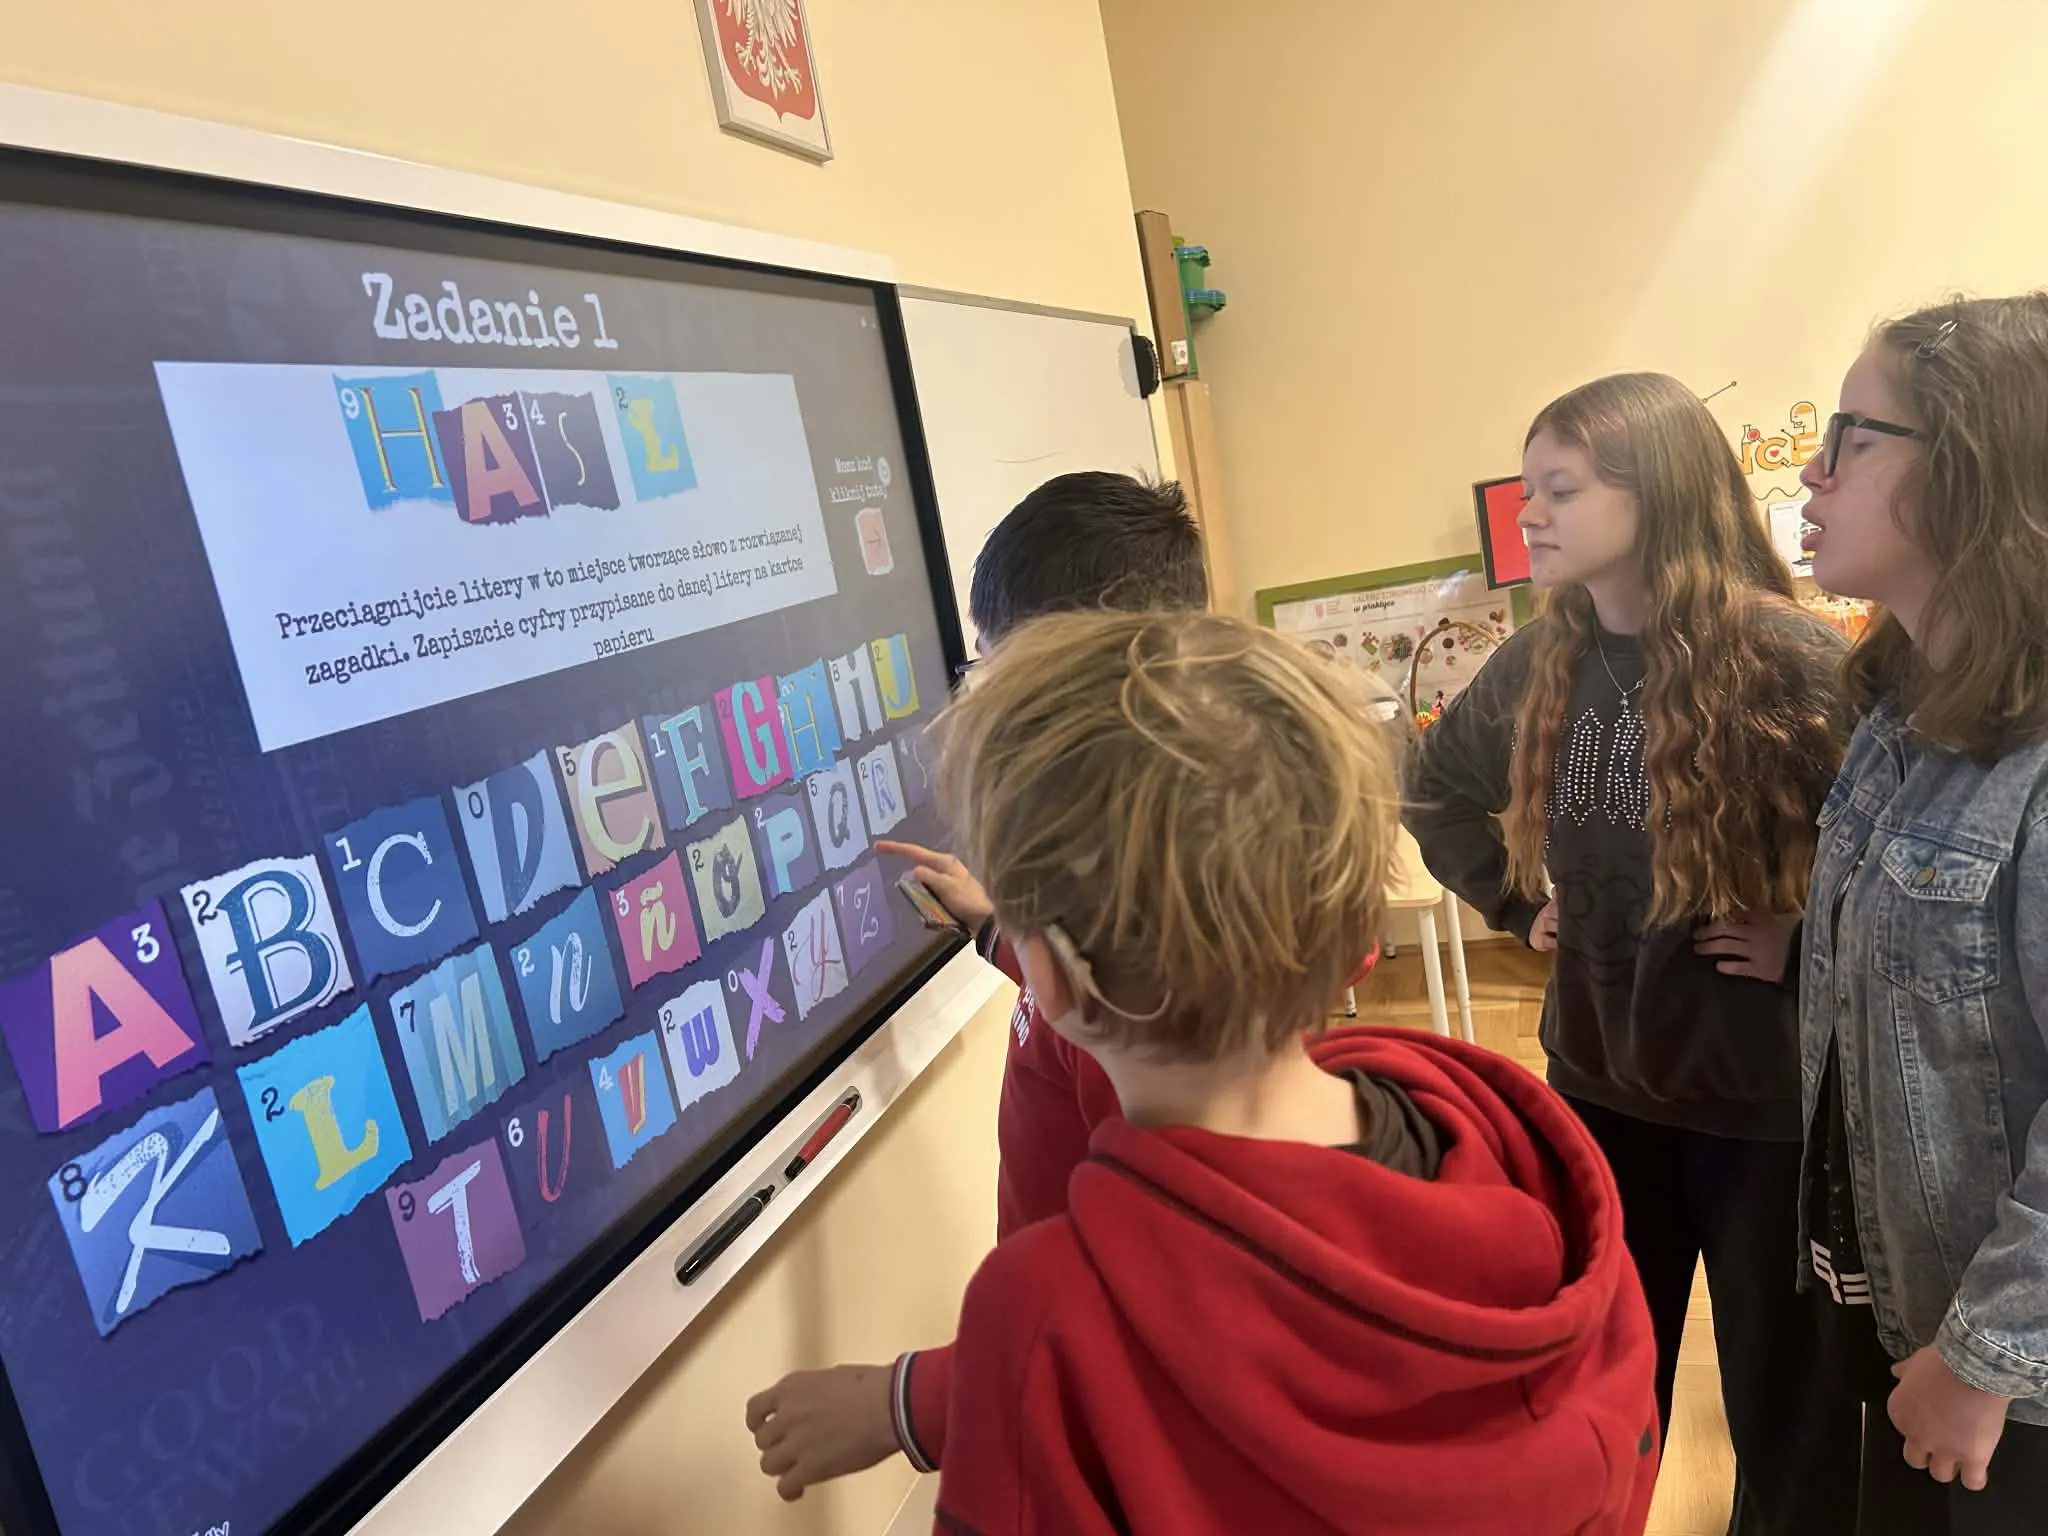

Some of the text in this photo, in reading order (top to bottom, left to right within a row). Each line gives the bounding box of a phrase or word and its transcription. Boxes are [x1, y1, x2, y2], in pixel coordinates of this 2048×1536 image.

[361, 271, 618, 349] Zadanie 1
[340, 387, 359, 419] 9
[503, 403, 517, 430] 3
[530, 401, 546, 426] 4
[460, 574, 522, 604] litery
[527, 572, 542, 591] w
[543, 567, 563, 588] to
[568, 557, 626, 584] miejsce
[691, 540, 728, 559] słowo
[729, 542, 738, 553] z
[305, 556, 804, 685] zagadki. Zapiszcie cyfry przypisane do danej litery na kartce
[592, 625, 656, 658] papieru
[562, 752, 576, 776] 5
[650, 732, 667, 758] 1
[660, 705, 710, 826] F
[731, 681, 781, 785] G
[335, 837, 361, 871] 1
[367, 831, 442, 937] C
[131, 923, 160, 963] 3
[192, 890, 218, 925] 2
[216, 869, 340, 1031] B
[50, 936, 195, 1129] A
[59, 1163, 89, 1202] 8
[82, 1107, 231, 1315] K
[261, 1087, 285, 1122] 2
[288, 1075, 380, 1191] L
[429, 971, 496, 1115] M
[517, 948, 535, 977] 2
[616, 889, 629, 916] 3
[692, 848, 704, 872] 2
[755, 807, 767, 829] 2
[764, 808, 804, 893] P
[428, 1160, 481, 1285] T
[508, 1117, 524, 1147] 6
[664, 1009, 676, 1034] 2
